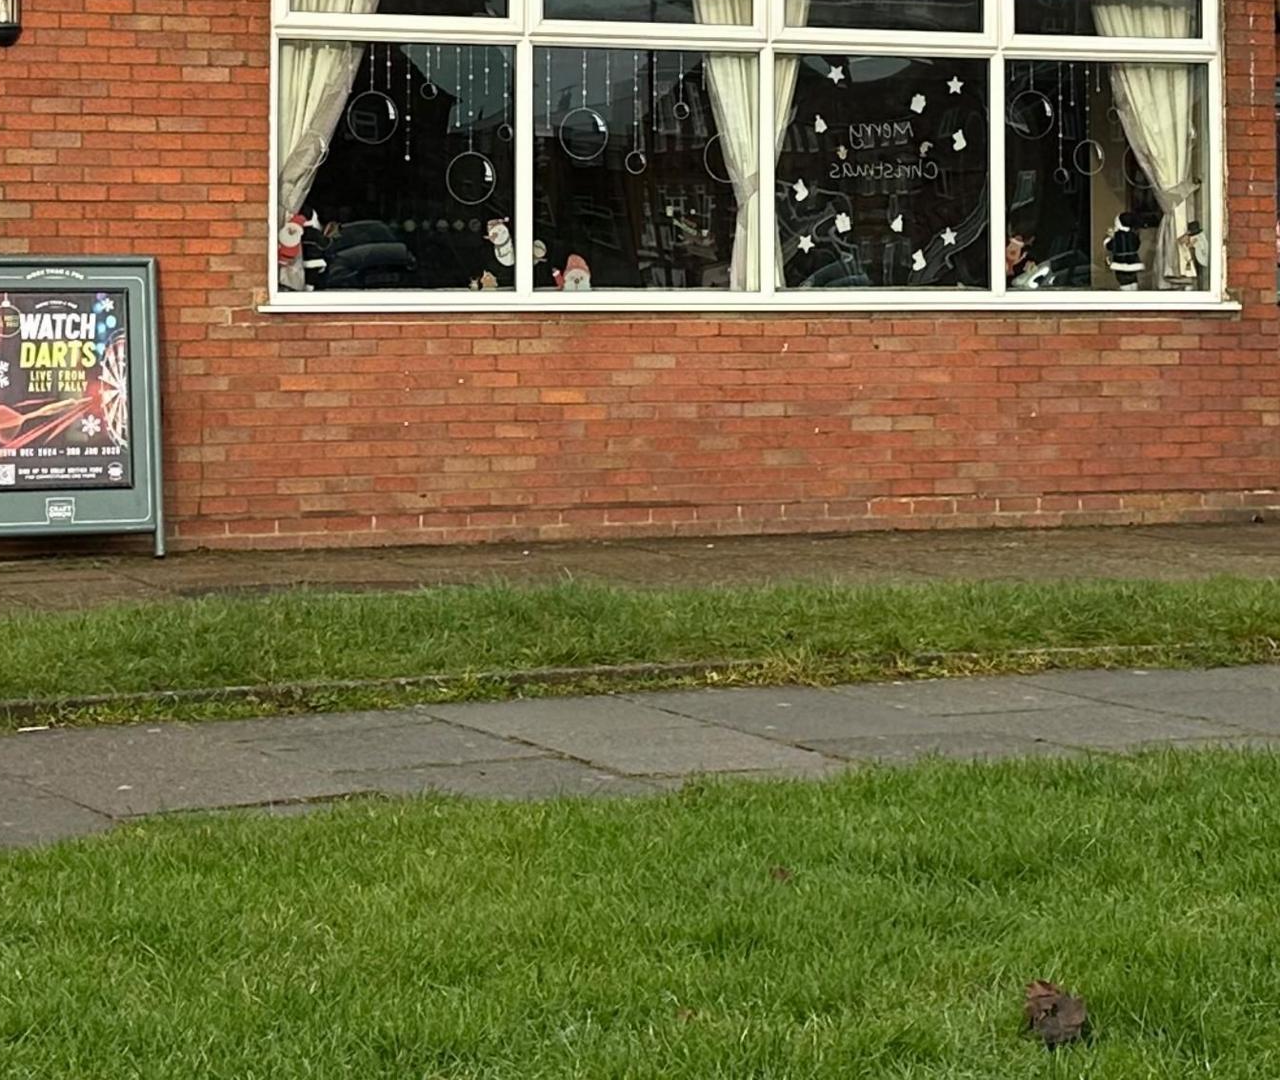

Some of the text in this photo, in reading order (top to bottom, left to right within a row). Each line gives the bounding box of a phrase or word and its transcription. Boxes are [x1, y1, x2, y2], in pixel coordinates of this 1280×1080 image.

[20, 313, 97, 340] WATCH
[20, 340, 97, 368] DARTS
[29, 370, 86, 381] LIVE FROM
[27, 381, 89, 392] ALLY PALLY
